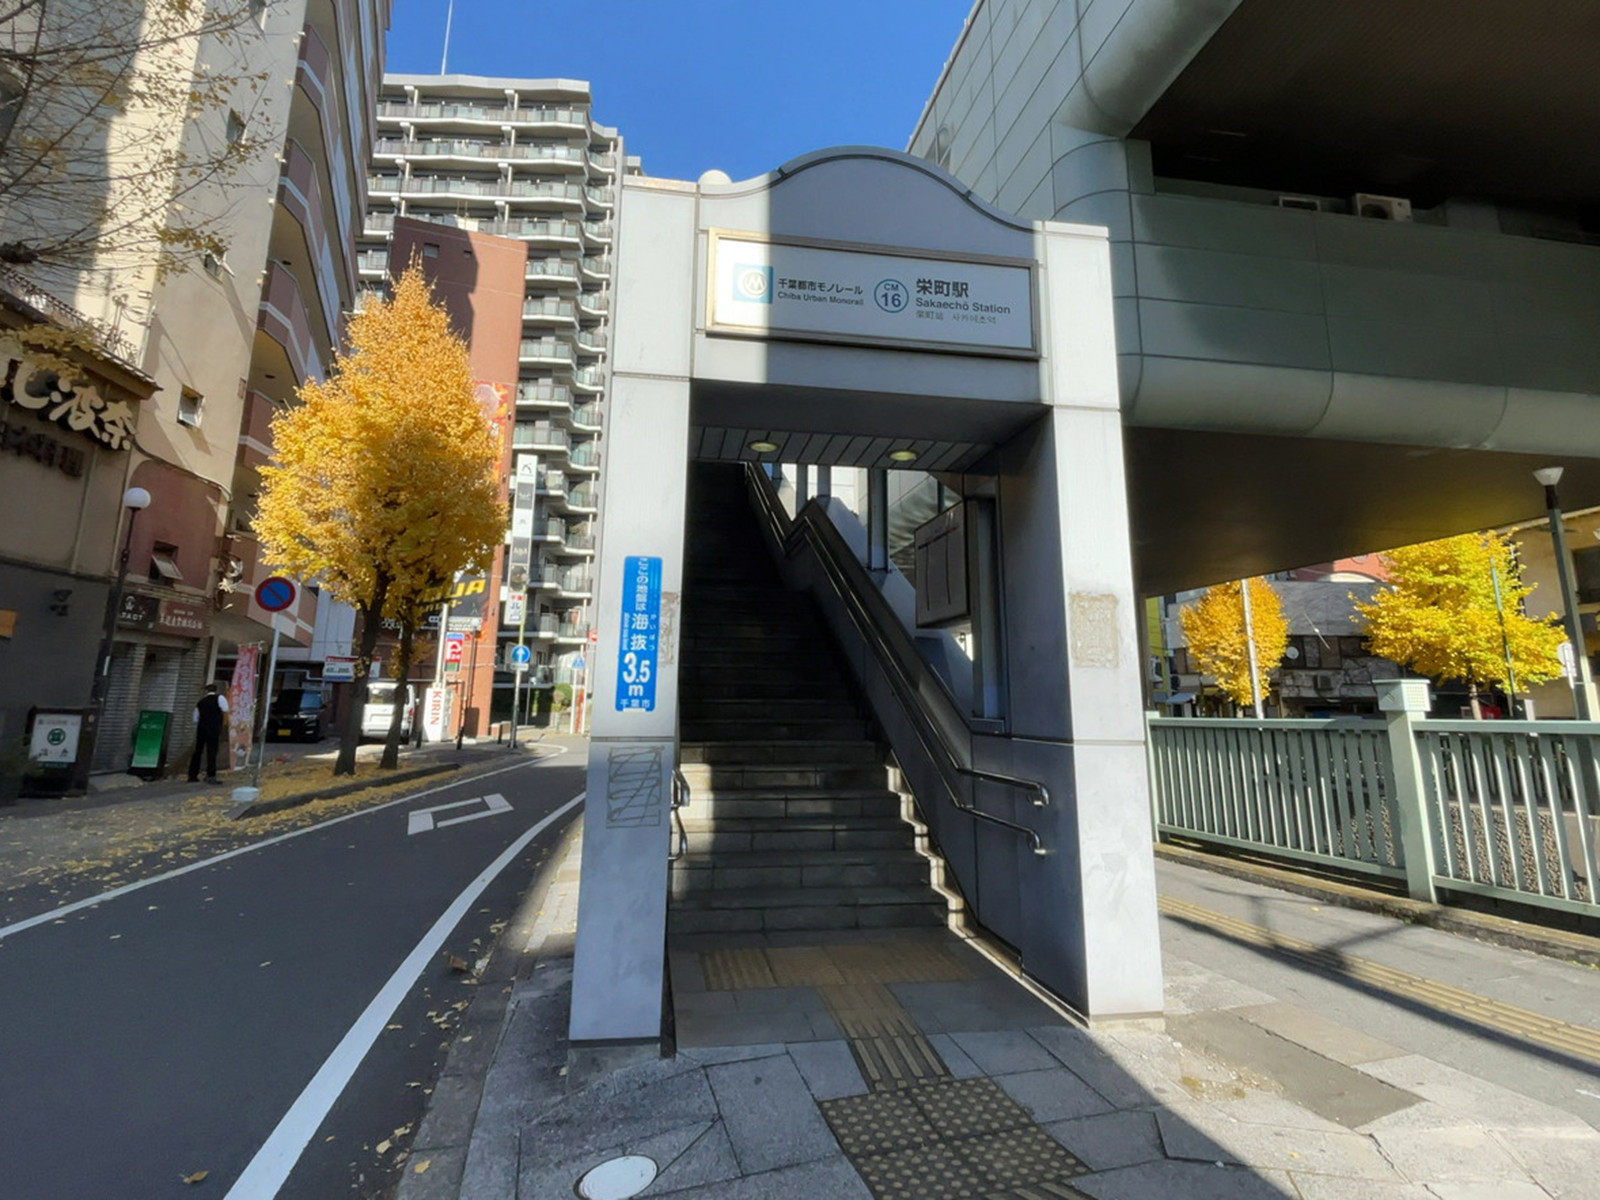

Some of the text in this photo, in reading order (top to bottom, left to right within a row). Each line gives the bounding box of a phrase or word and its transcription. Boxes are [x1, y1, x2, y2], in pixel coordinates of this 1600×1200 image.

[777, 278, 864, 296] 千葉都市モノレール
[883, 283, 900, 292] CM
[915, 277, 970, 299] 栄町駅
[777, 292, 865, 307] Chiba Urban Monorail
[881, 292, 902, 309] 16
[972, 302, 1011, 315] Station
[630, 613, 649, 651] 海抜
[622, 652, 651, 683] 3.5
[629, 682, 644, 697] m
[430, 690, 443, 725] KIRIN
